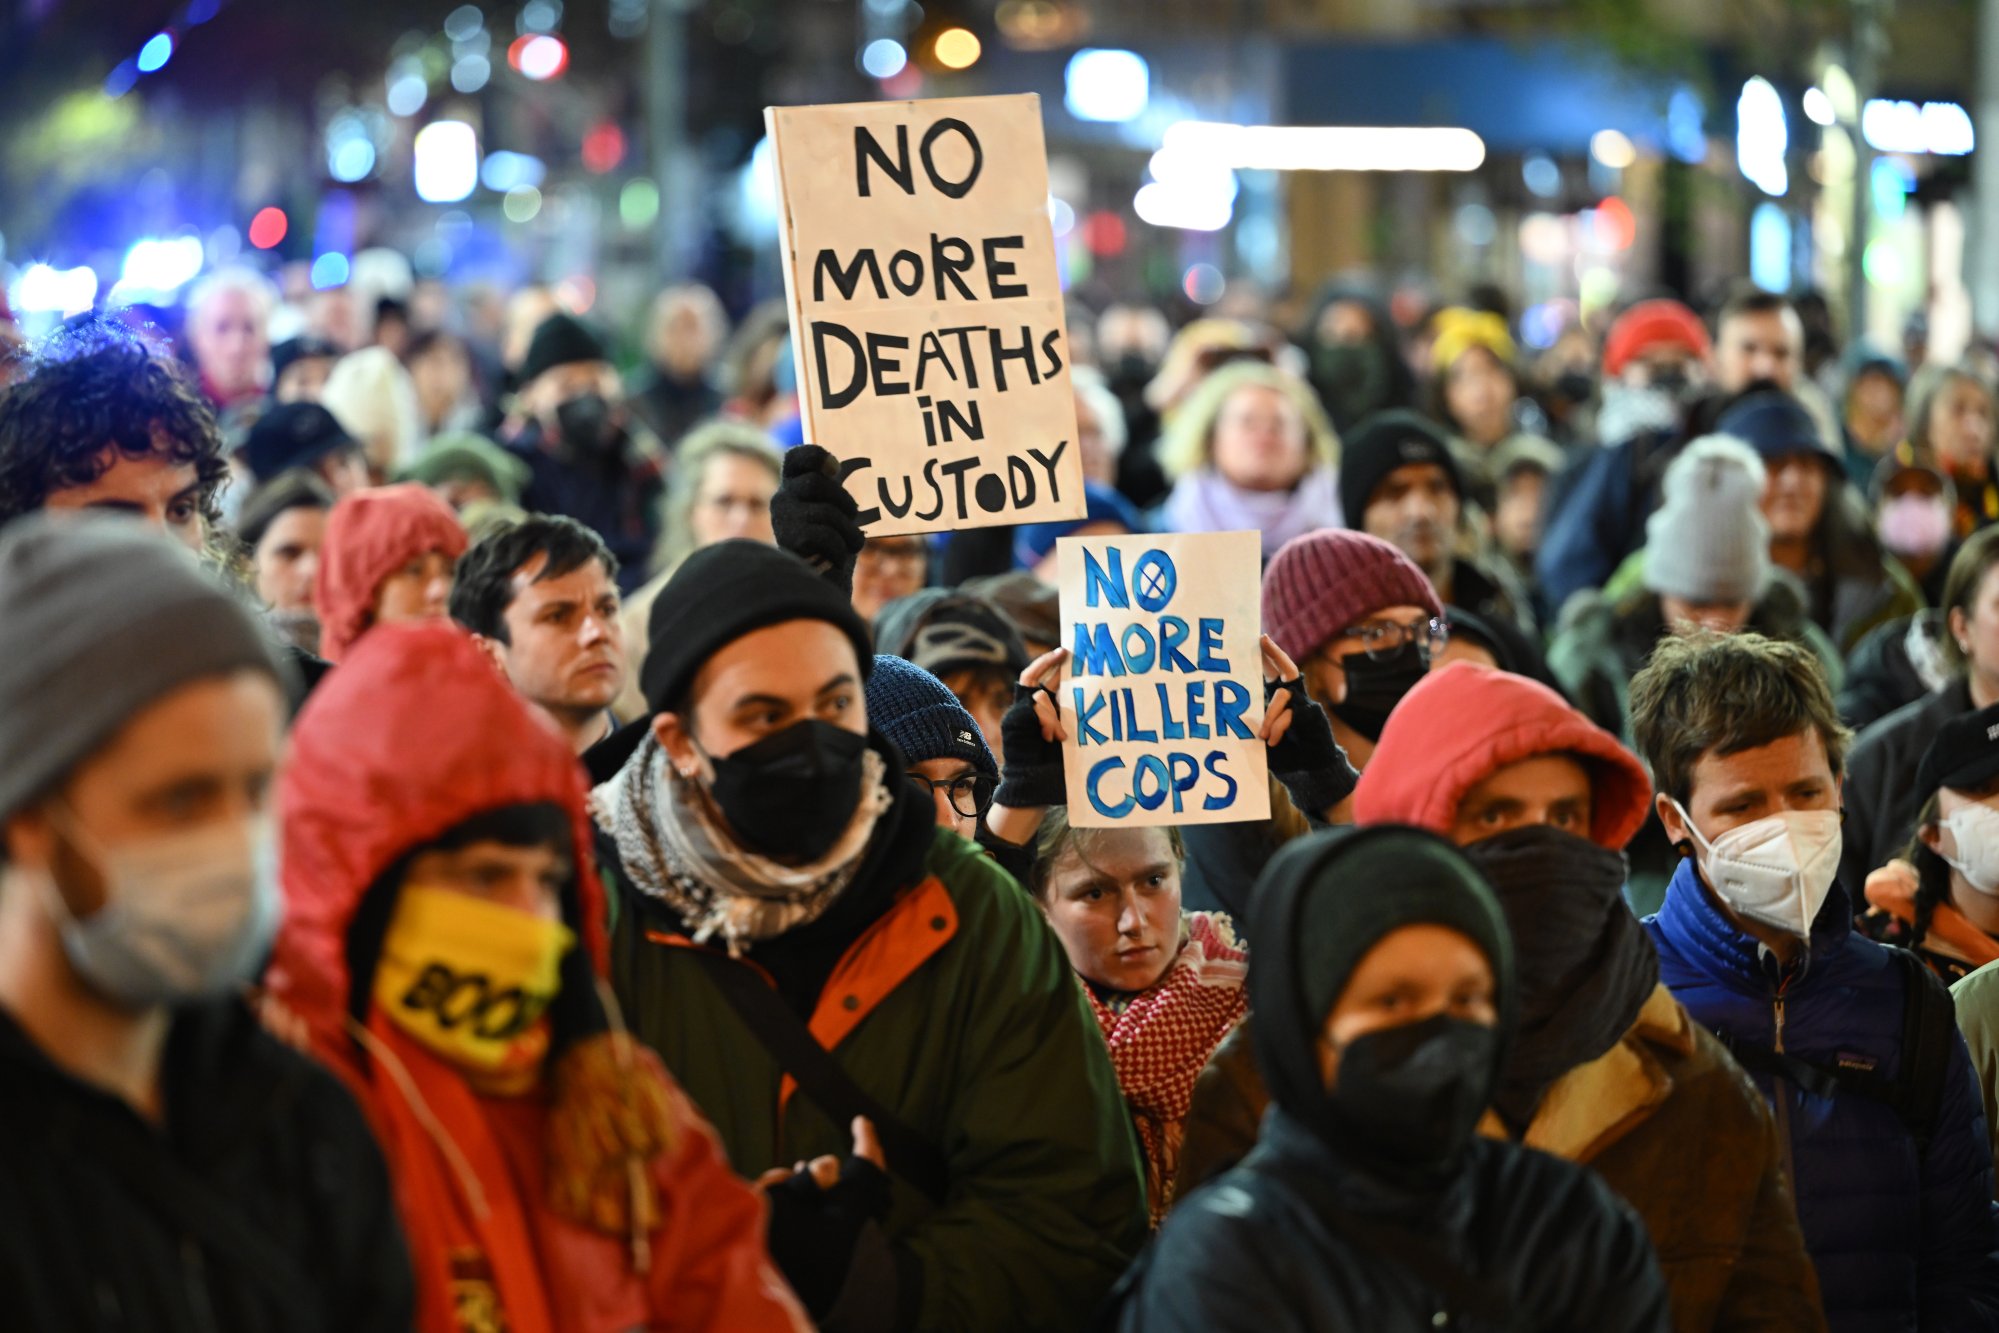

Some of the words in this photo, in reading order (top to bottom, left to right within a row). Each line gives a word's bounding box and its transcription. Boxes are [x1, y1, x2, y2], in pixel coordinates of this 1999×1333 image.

[854, 117, 983, 199] NO
[813, 233, 1029, 302] MORE
[811, 320, 1063, 410] DEATHS
[1082, 546, 1177, 613] NO
[1072, 615, 1231, 677] MORE
[1073, 680, 1255, 746] KILLER
[1086, 750, 1237, 818] COPS
